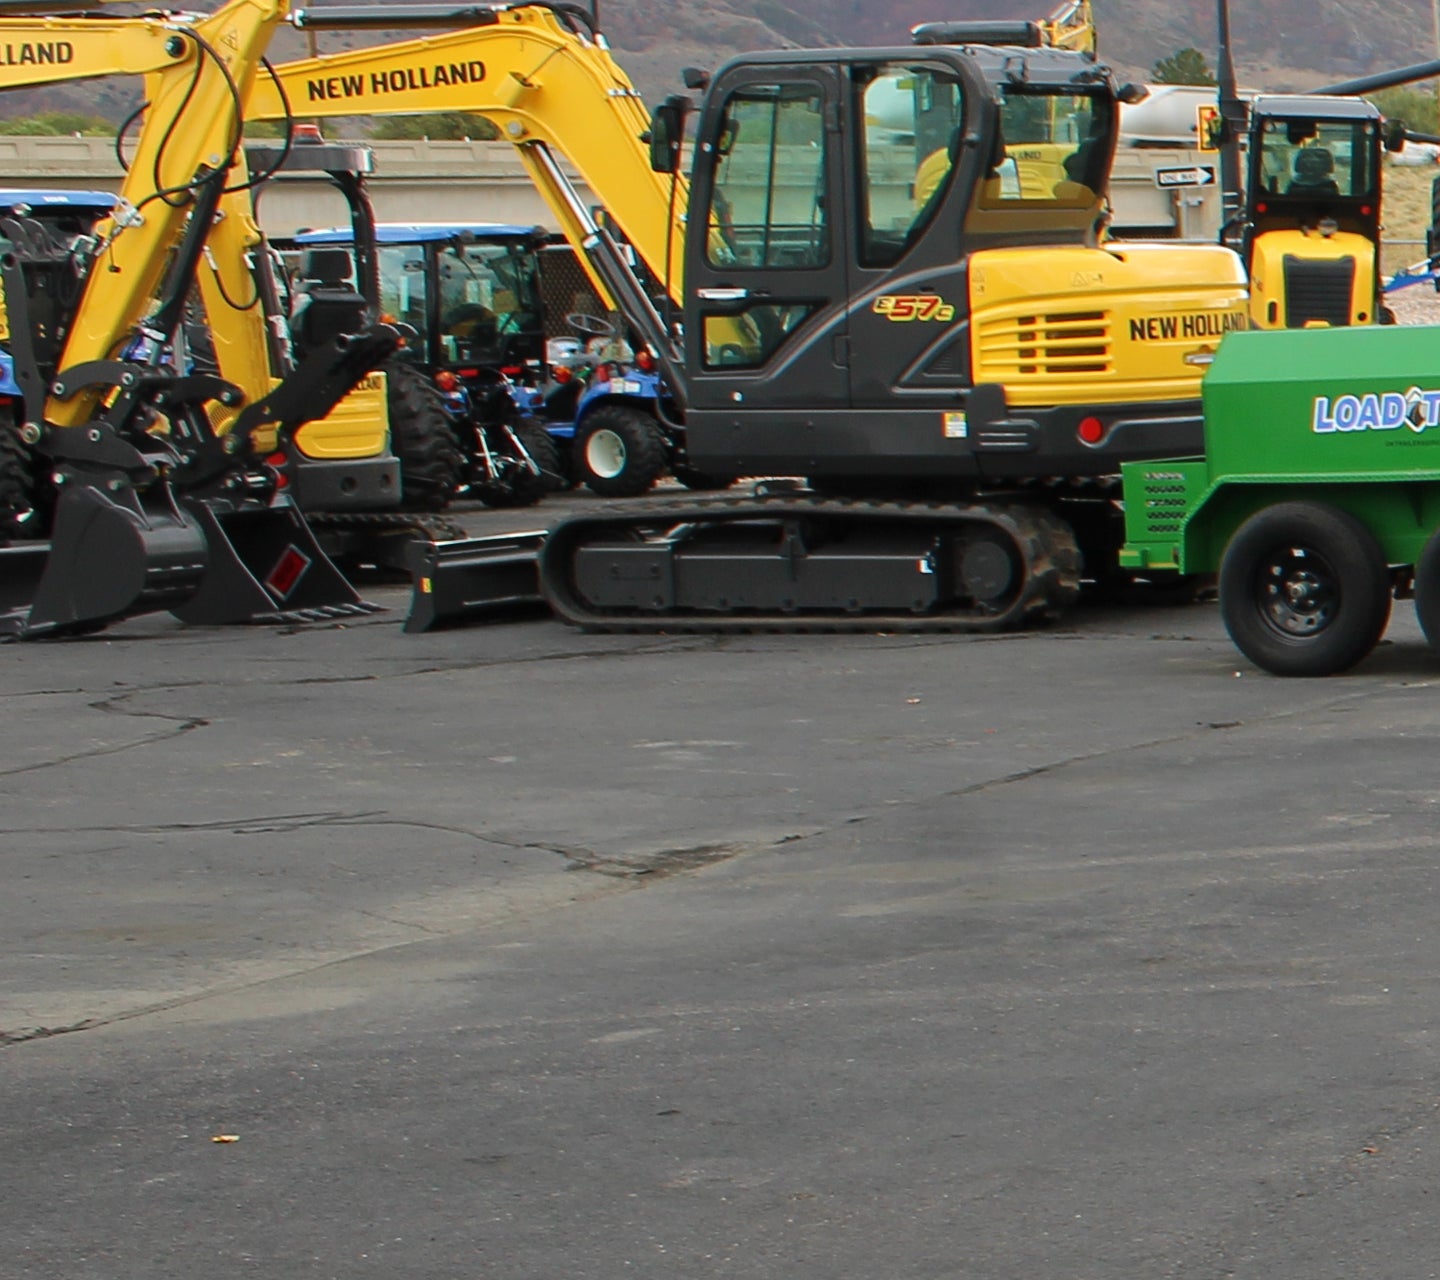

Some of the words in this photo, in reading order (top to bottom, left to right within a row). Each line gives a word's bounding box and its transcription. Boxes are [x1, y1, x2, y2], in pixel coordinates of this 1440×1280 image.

[308, 75, 363, 101] NEW
[371, 60, 486, 94] HOLLAND
[1130, 317, 1177, 340] NEW
[1182, 313, 1247, 338] HOLLAND
[1314, 392, 1406, 433] LOAD
